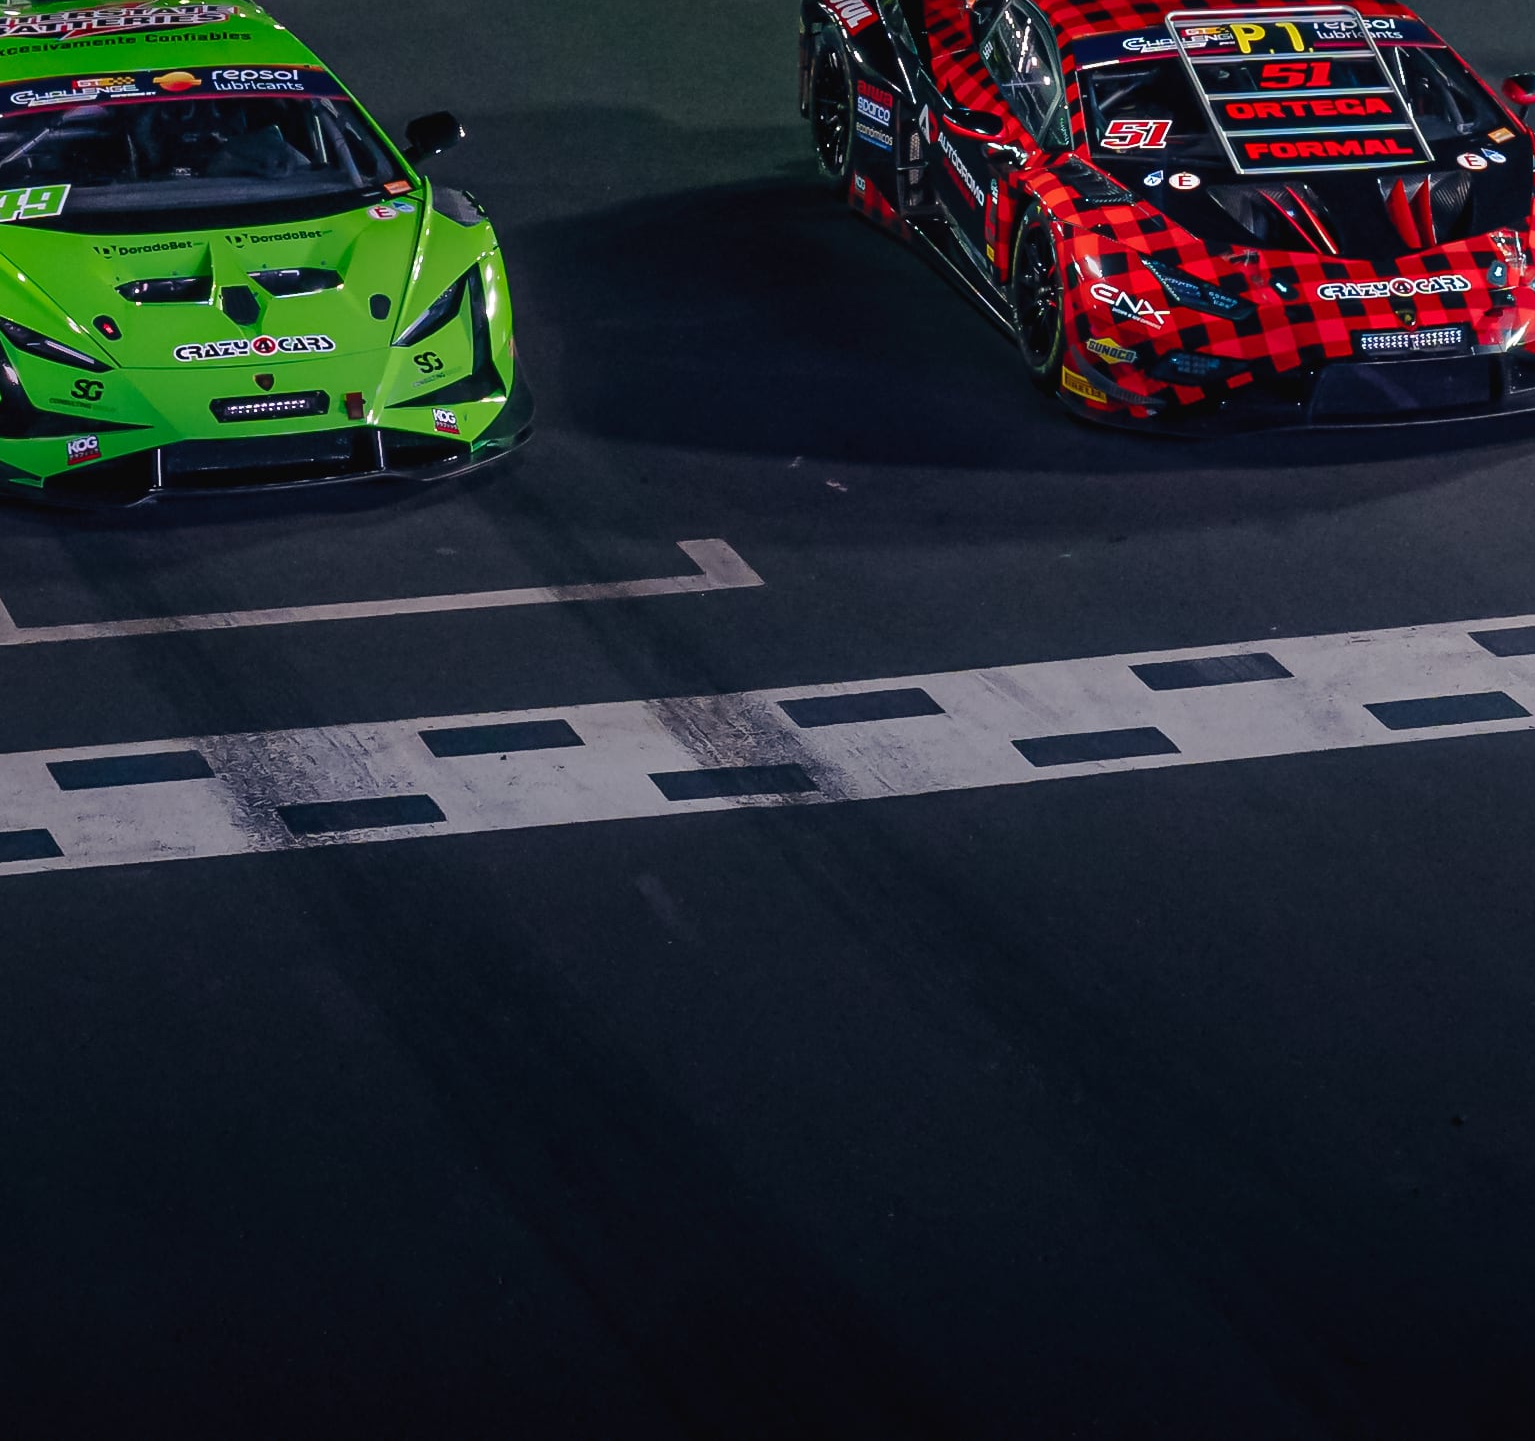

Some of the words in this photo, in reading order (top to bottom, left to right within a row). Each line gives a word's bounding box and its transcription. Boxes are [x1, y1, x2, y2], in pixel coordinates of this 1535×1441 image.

[144, 31, 252, 44] Confiables
[212, 69, 298, 86] repsol
[214, 80, 305, 92] lubricants
[1260, 61, 1332, 88] 51
[10, 84, 139, 106] CHALLENGE
[857, 79, 894, 107] aiwa
[857, 96, 891, 123] sparco
[1226, 97, 1393, 120] ORTEGA
[1101, 120, 1172, 149] 51
[1245, 137, 1414, 160] FORMAL
[118, 240, 193, 256] DoradoBet
[250, 229, 323, 244] DoradoBet
[1318, 280, 1390, 300] CRAZY
[1414, 275, 1472, 294] CARS
[1090, 283, 1171, 326] ENX
[175, 340, 249, 362] CRAZY
[277, 336, 335, 353] CARS
[1088, 340, 1135, 361] SUNOCO
[413, 351, 444, 374] SG
[70, 378, 105, 402] SG
[432, 408, 457, 425] KOG
[67, 435, 98, 455] KOG
